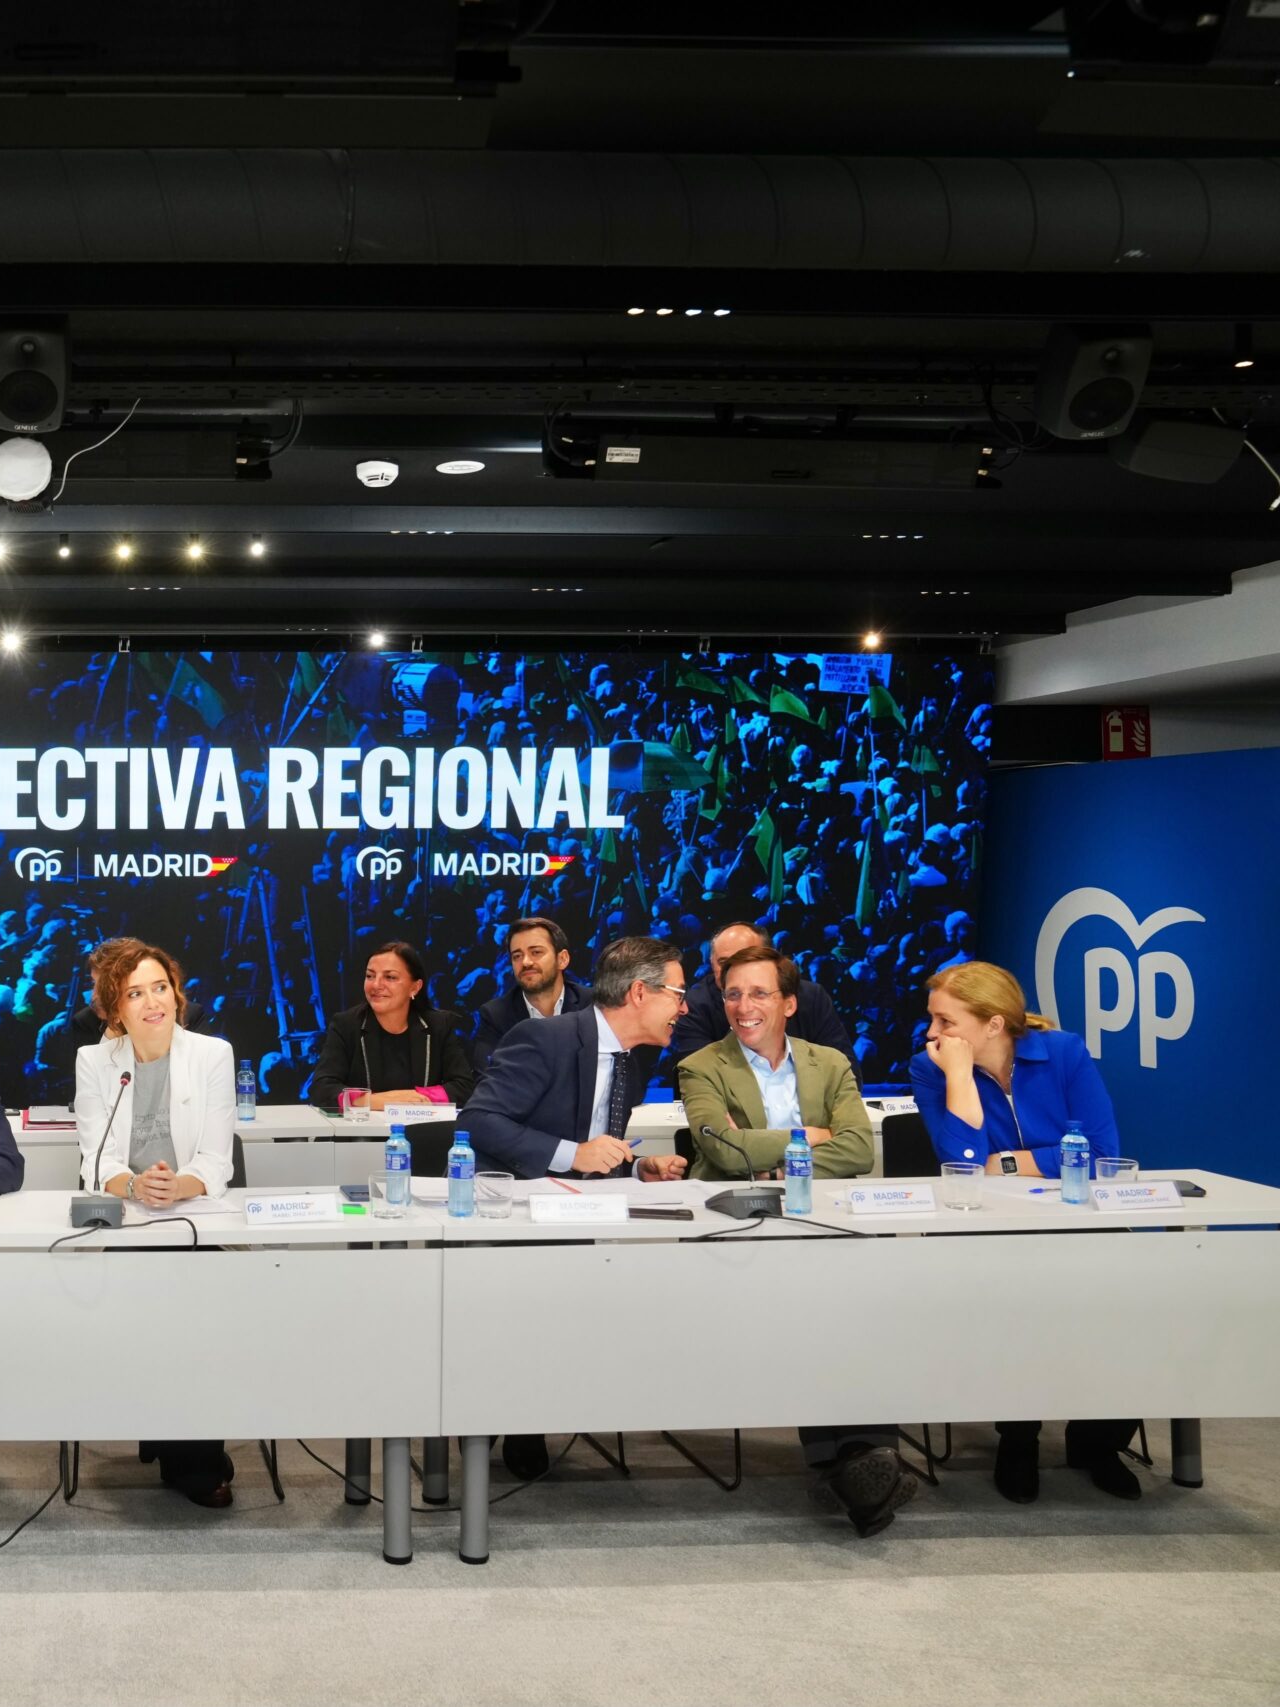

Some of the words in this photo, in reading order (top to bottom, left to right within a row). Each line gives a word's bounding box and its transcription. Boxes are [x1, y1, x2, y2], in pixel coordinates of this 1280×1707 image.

[267, 746, 625, 830] REGIONAL
[94, 854, 213, 877] MADRID
[434, 852, 550, 876] MADRID
[873, 1191, 907, 1201] MADRID
[1116, 1188, 1149, 1197] MADRID
[271, 1202, 309, 1211] MADRID
